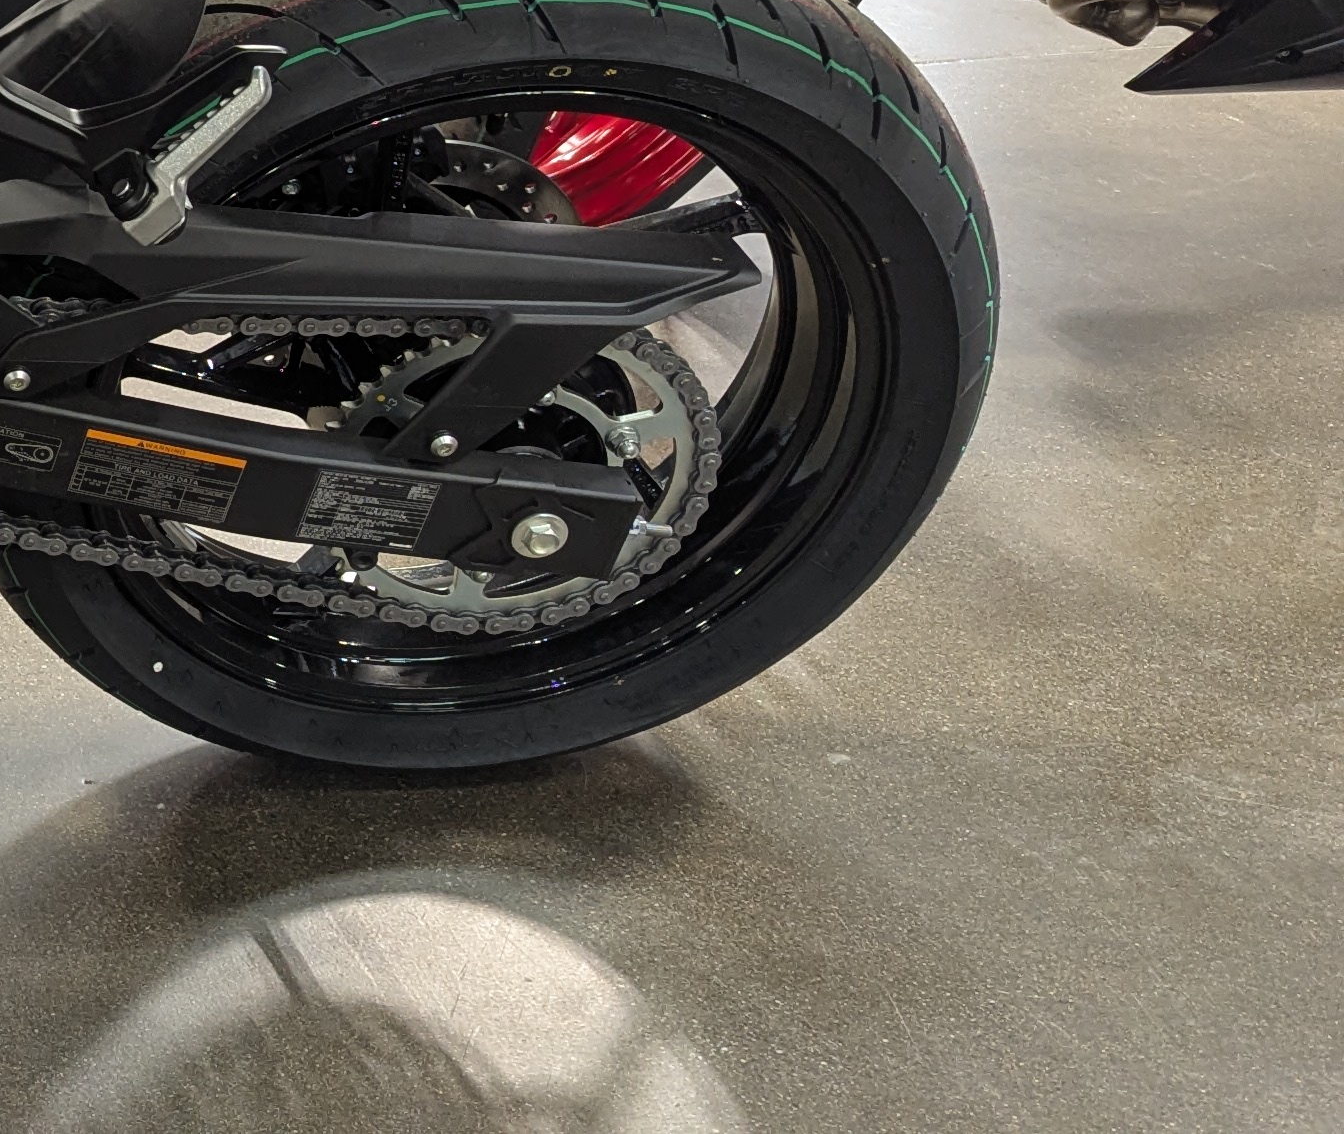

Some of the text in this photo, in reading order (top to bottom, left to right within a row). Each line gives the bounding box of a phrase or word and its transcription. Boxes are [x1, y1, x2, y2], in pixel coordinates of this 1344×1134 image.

[145, 442, 187, 456] WARNING
[134, 467, 151, 477] AND
[153, 470, 176, 482] LOAD
[177, 475, 199, 486] DATA
